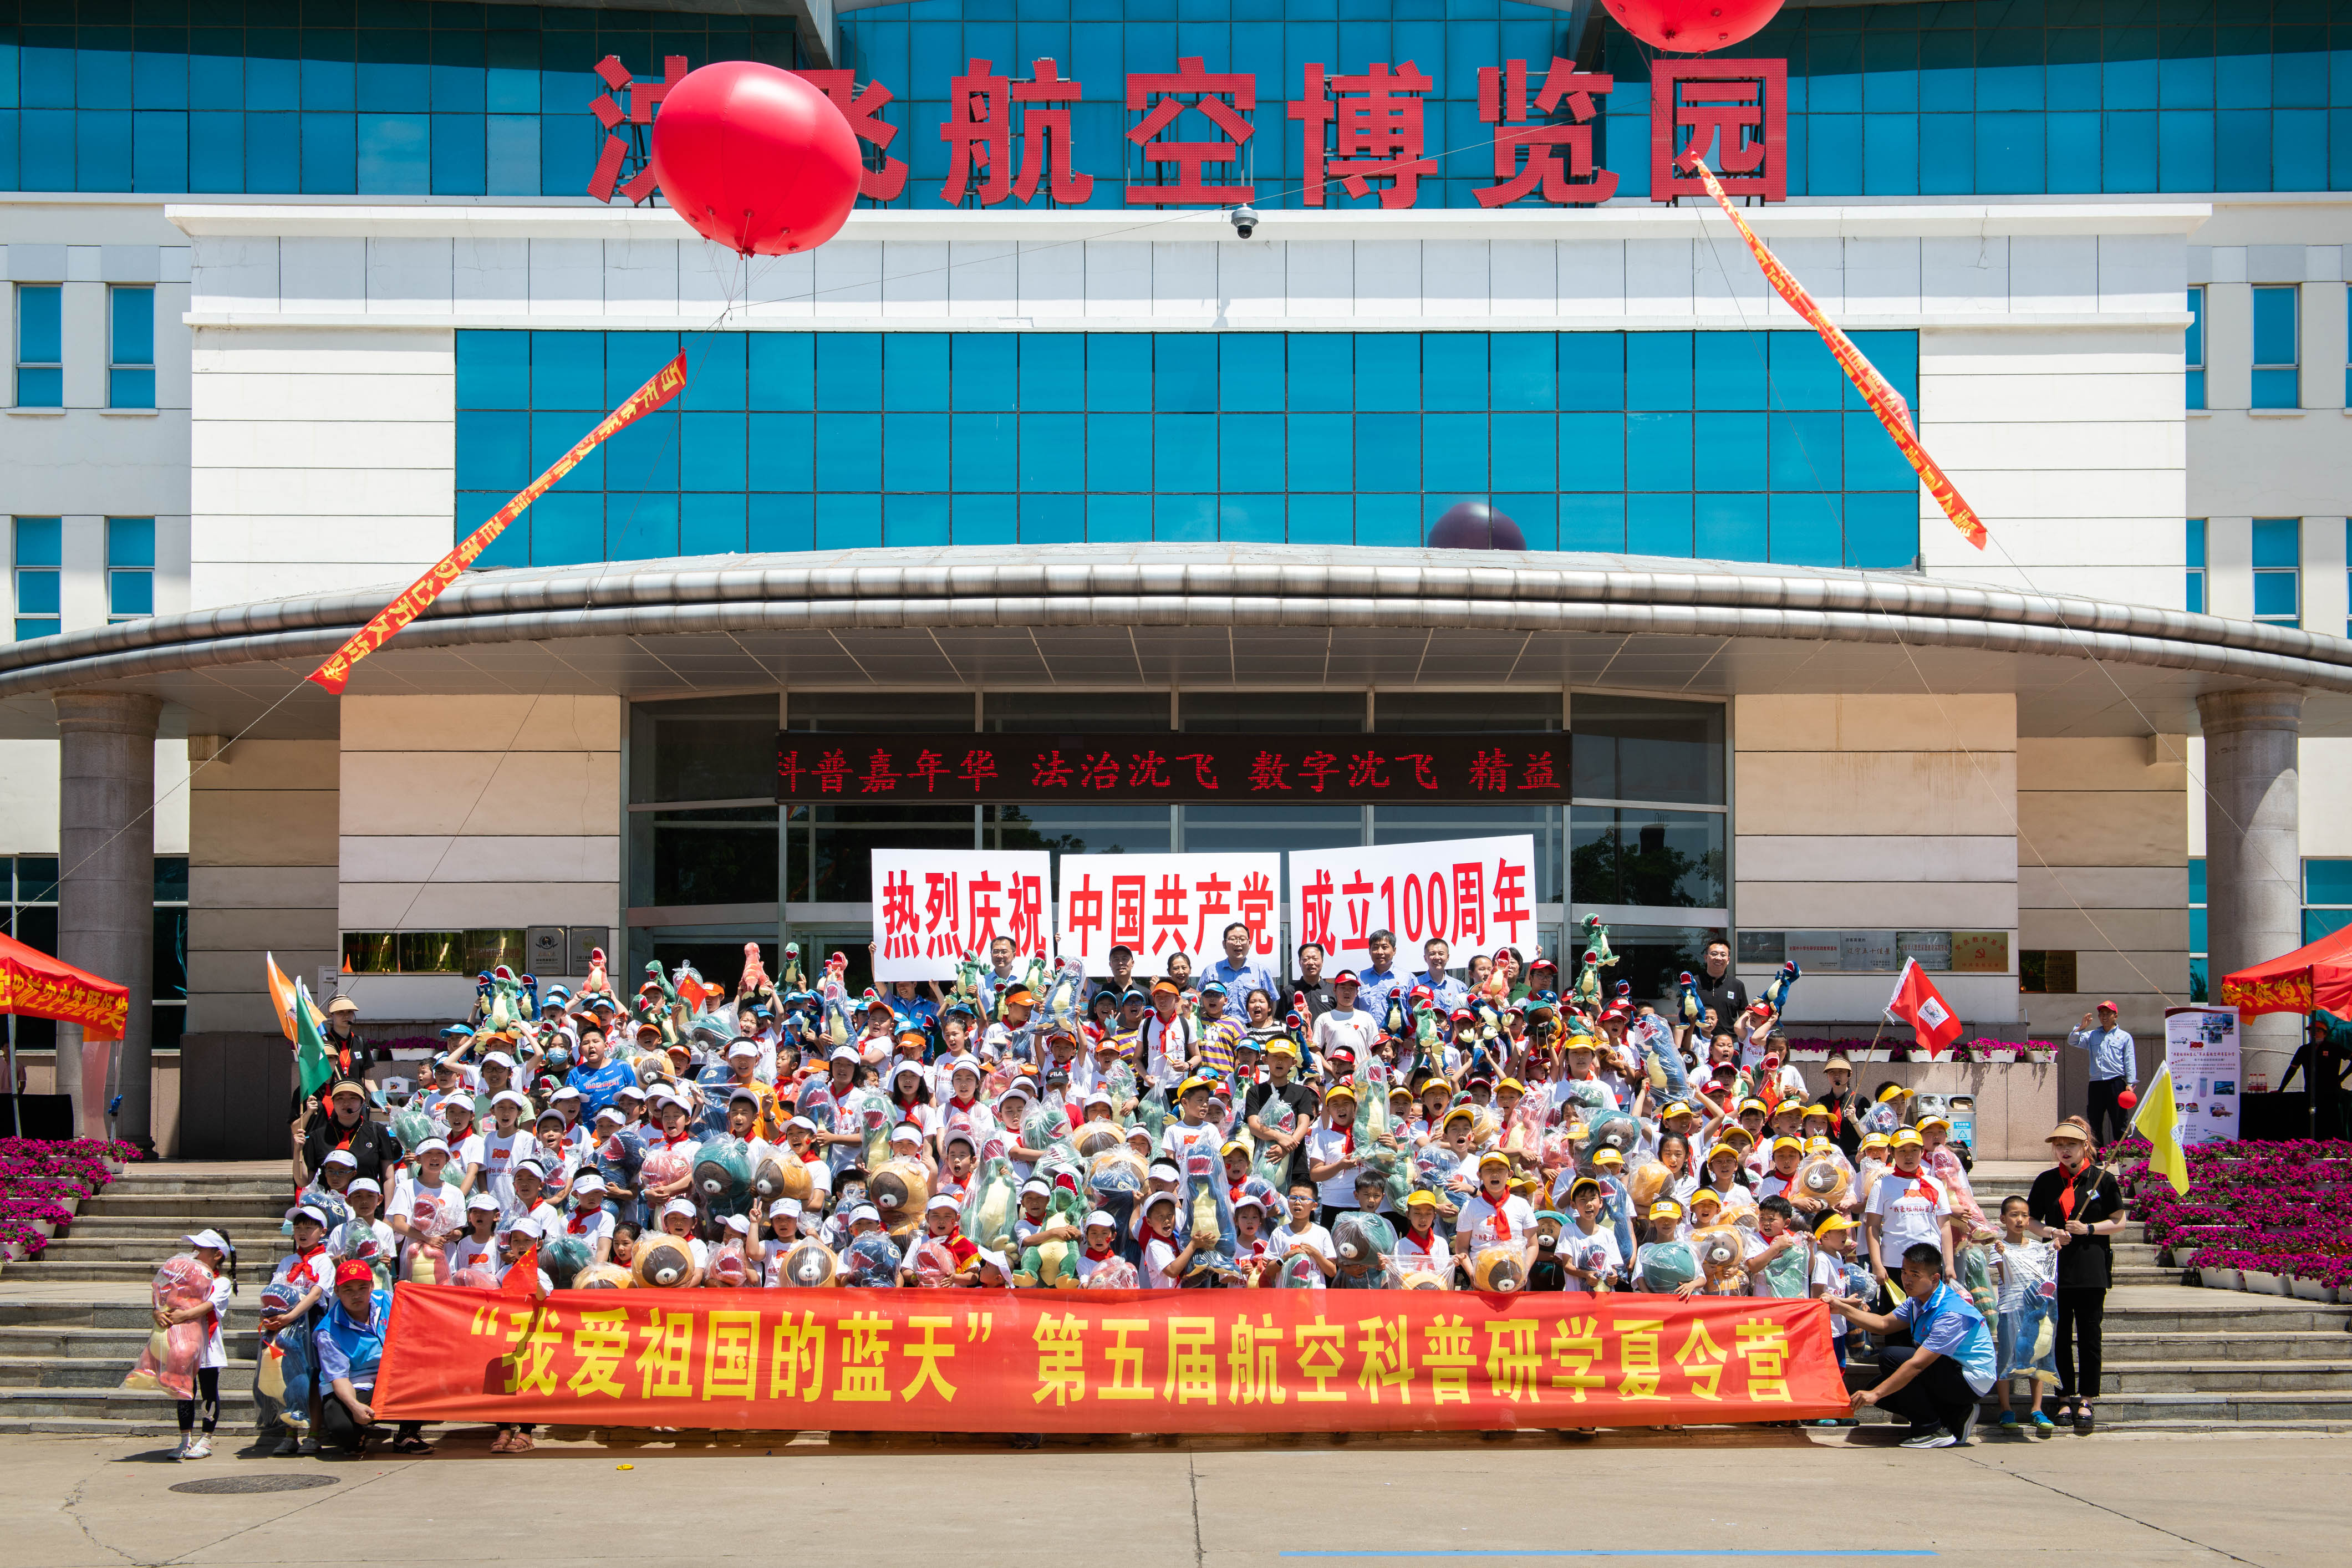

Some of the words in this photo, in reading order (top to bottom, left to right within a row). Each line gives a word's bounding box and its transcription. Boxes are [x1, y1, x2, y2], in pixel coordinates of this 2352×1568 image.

[1033, 750, 1218, 788] 法治沈飞
[1248, 750, 1438, 792] 数字沈飞
[1468, 747, 1561, 792] 精益
[883, 870, 1046, 960] 热烈庆祝
[1068, 871, 1274, 957] 中国共产党
[1301, 857, 1530, 957] 成立100周年
[492, 1148, 510, 1159] 100
[468, 1254, 488, 1265] 100
[470, 1306, 992, 1403] “我爱祖国的蓝天”
[1032, 1312, 1794, 1406] 第五届航空科普研学夏令营
